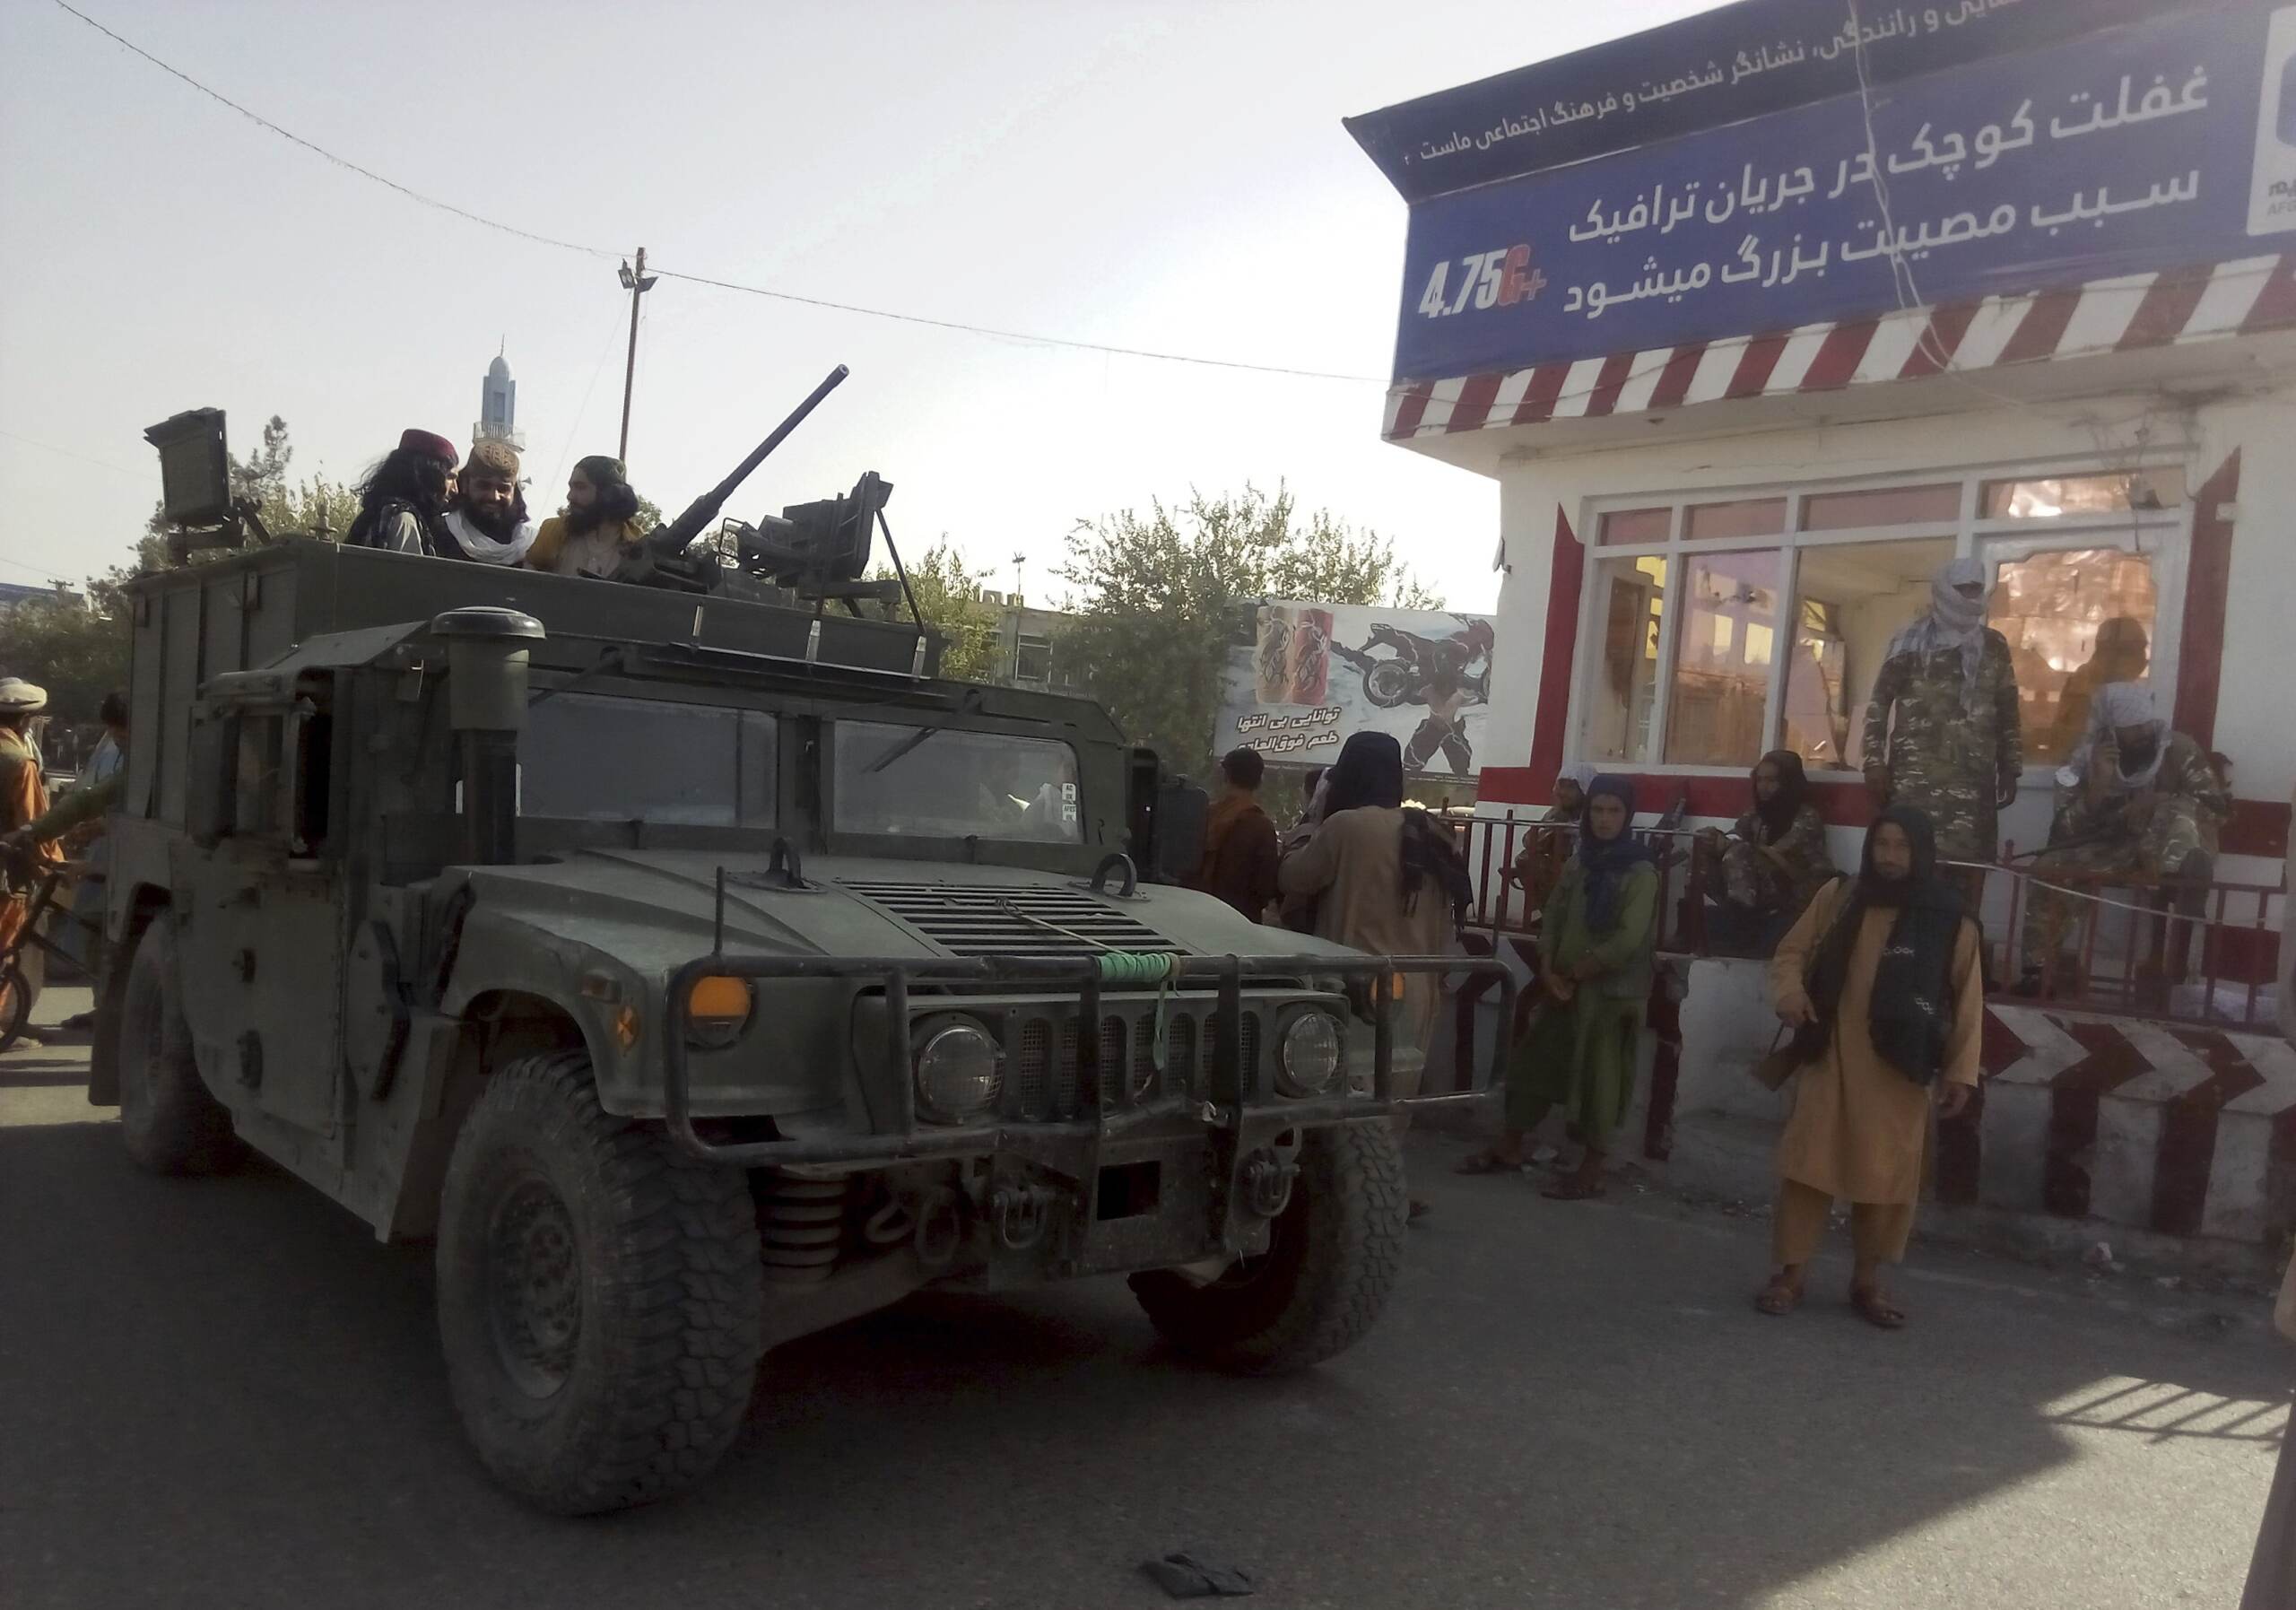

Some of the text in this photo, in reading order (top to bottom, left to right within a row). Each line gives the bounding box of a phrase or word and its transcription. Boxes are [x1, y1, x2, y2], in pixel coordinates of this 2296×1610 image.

[1923, 9, 1940, 33] و
[1731, 40, 1805, 85] نشانگر
[1639, 61, 1724, 103] شخصیت
[1550, 92, 1618, 126] فرهنگ
[1622, 92, 1636, 113] و
[1420, 132, 1472, 160] ماست
[1476, 108, 1548, 151] اجتماعی
[1569, 65, 2208, 244] غفلت کوچک در جریان ترافیک
[2031, 170, 2200, 237] سبب
[1840, 203, 2017, 263] مصیبت
[1720, 234, 1830, 287] بزرگ
[1238, 713, 1268, 734] انتها
[1268, 716, 1290, 730] بی
[1306, 731, 1340, 750] طعم
